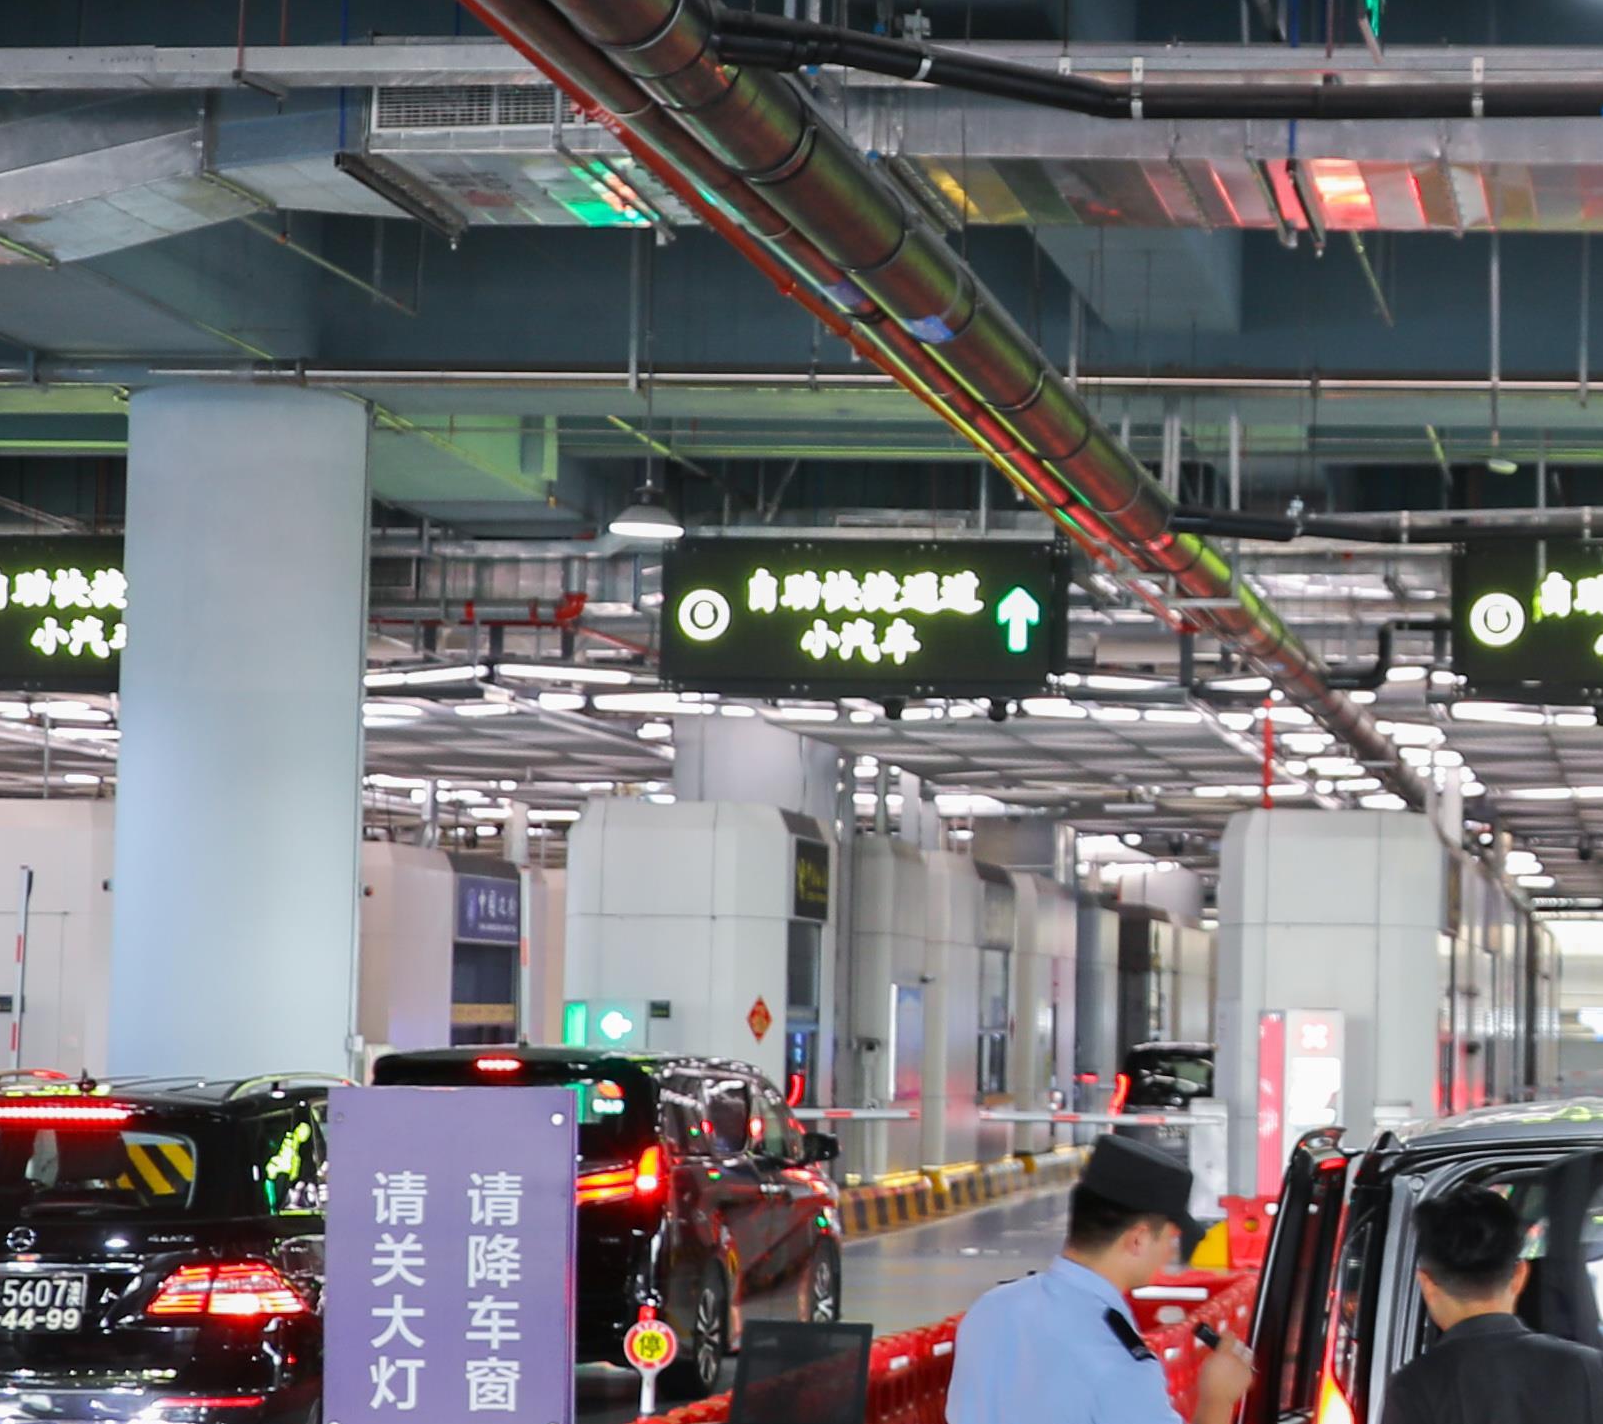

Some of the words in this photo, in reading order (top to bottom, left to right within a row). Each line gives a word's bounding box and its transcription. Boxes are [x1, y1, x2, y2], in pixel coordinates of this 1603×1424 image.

[800, 618, 921, 665] 小汽车
[370, 1172, 429, 1411] 请关大灯
[465, 1172, 522, 1413] 请降车窗
[639, 1333, 663, 1359] 停
